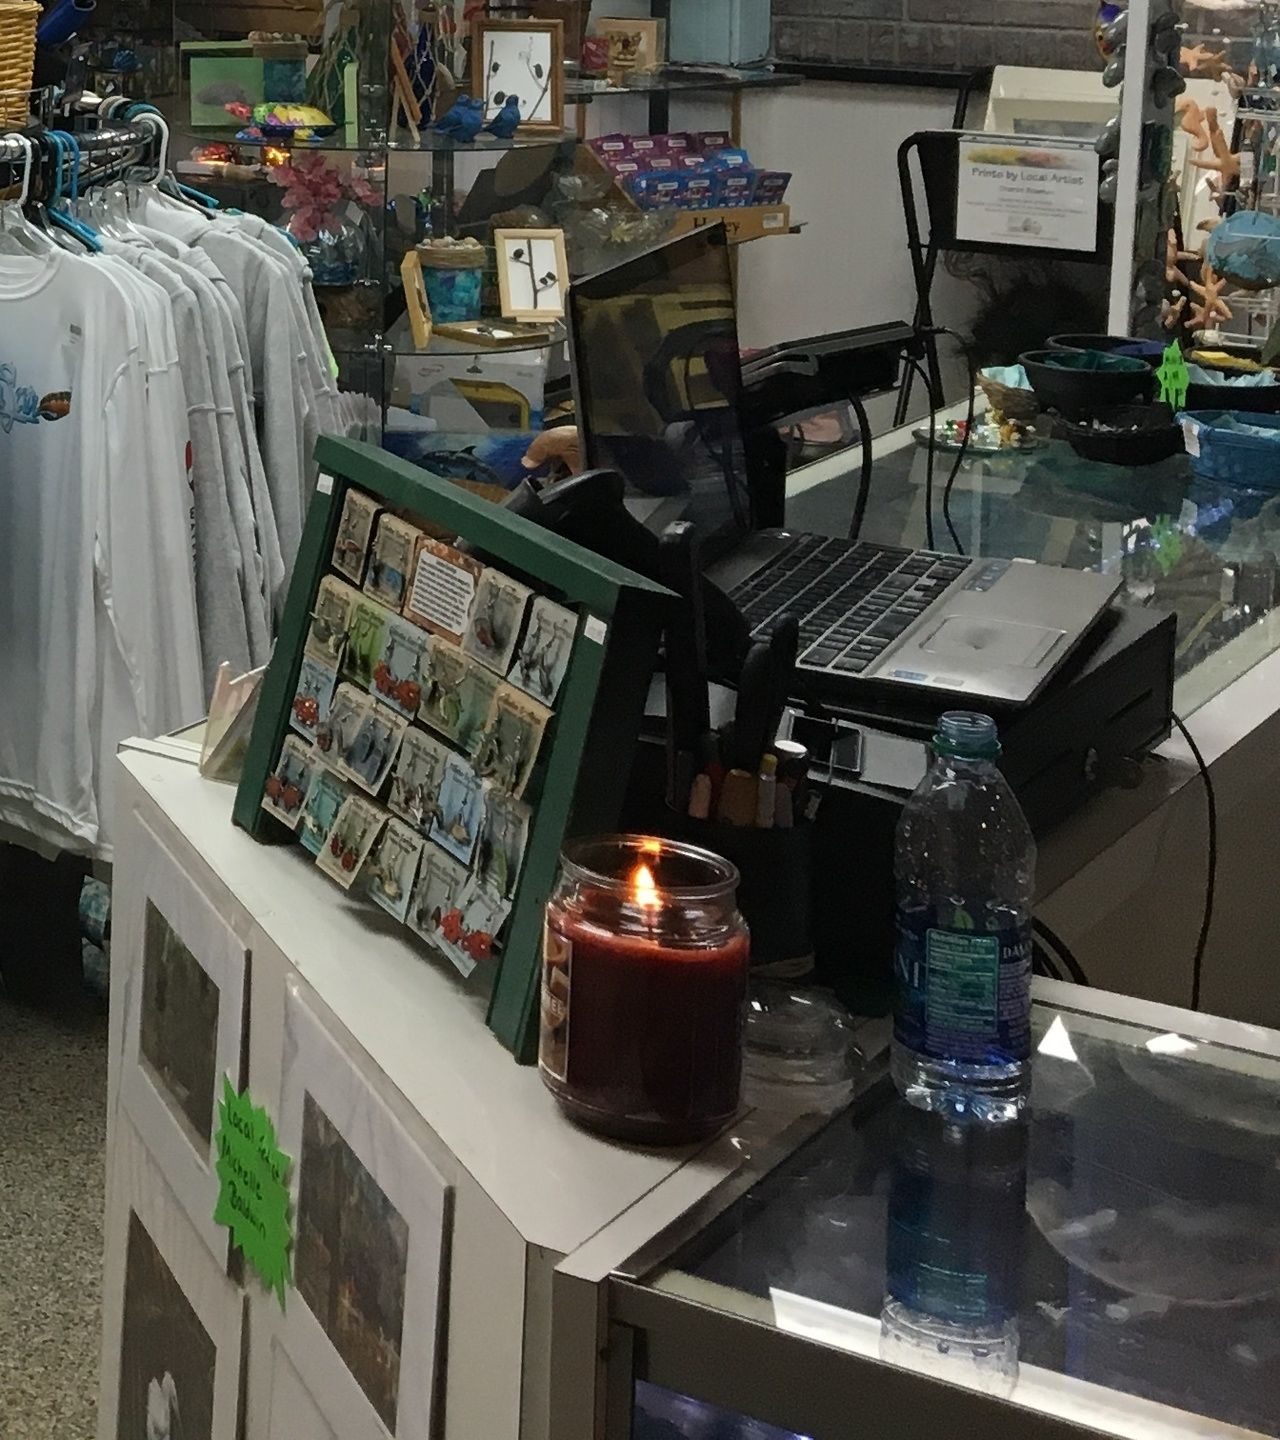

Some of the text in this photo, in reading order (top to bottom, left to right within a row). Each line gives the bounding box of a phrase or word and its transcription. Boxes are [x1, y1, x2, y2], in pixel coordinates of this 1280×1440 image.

[1006, 170, 1019, 182] by
[1021, 171, 1048, 182] Local
[1052, 173, 1084, 185] Artist
[227, 1101, 255, 1143] Local
[222, 1133, 263, 1201] Michelle
[228, 1180, 267, 1240] Baldwin
